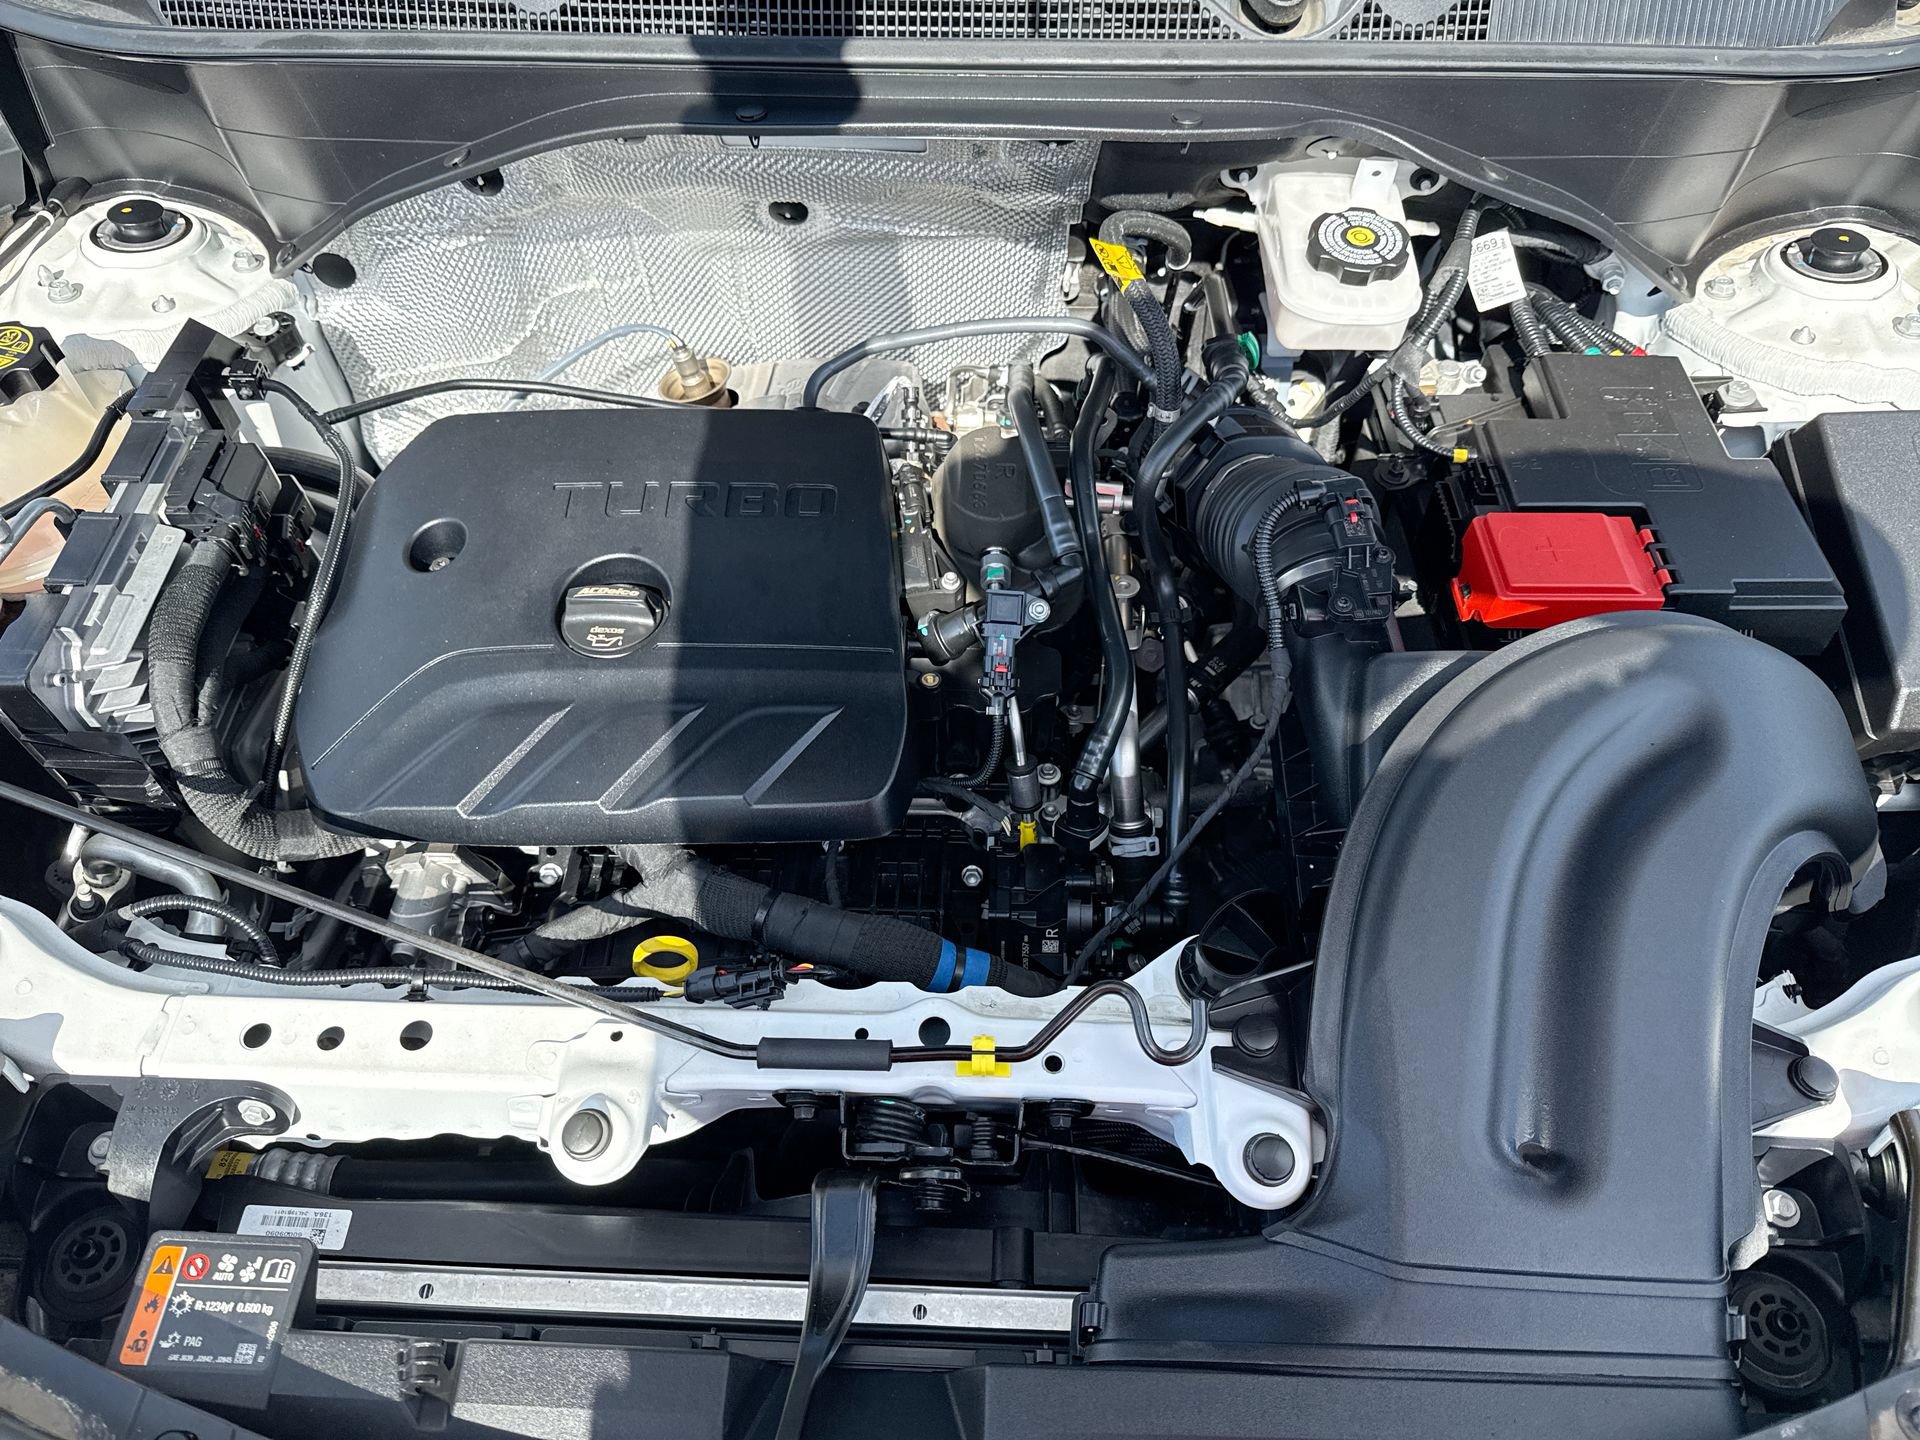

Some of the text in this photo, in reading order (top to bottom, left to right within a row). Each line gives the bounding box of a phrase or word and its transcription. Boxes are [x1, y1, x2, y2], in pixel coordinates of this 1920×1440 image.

[553, 481, 838, 518] TURBO
[576, 587, 640, 597] ACDelco
[590, 626, 626, 634] dexos
[1045, 928, 1059, 938] R
[212, 1272, 234, 1282] AUTO
[194, 1300, 274, 1316] R-1234yf 0.600 kg
[183, 1336, 203, 1347] PAG
